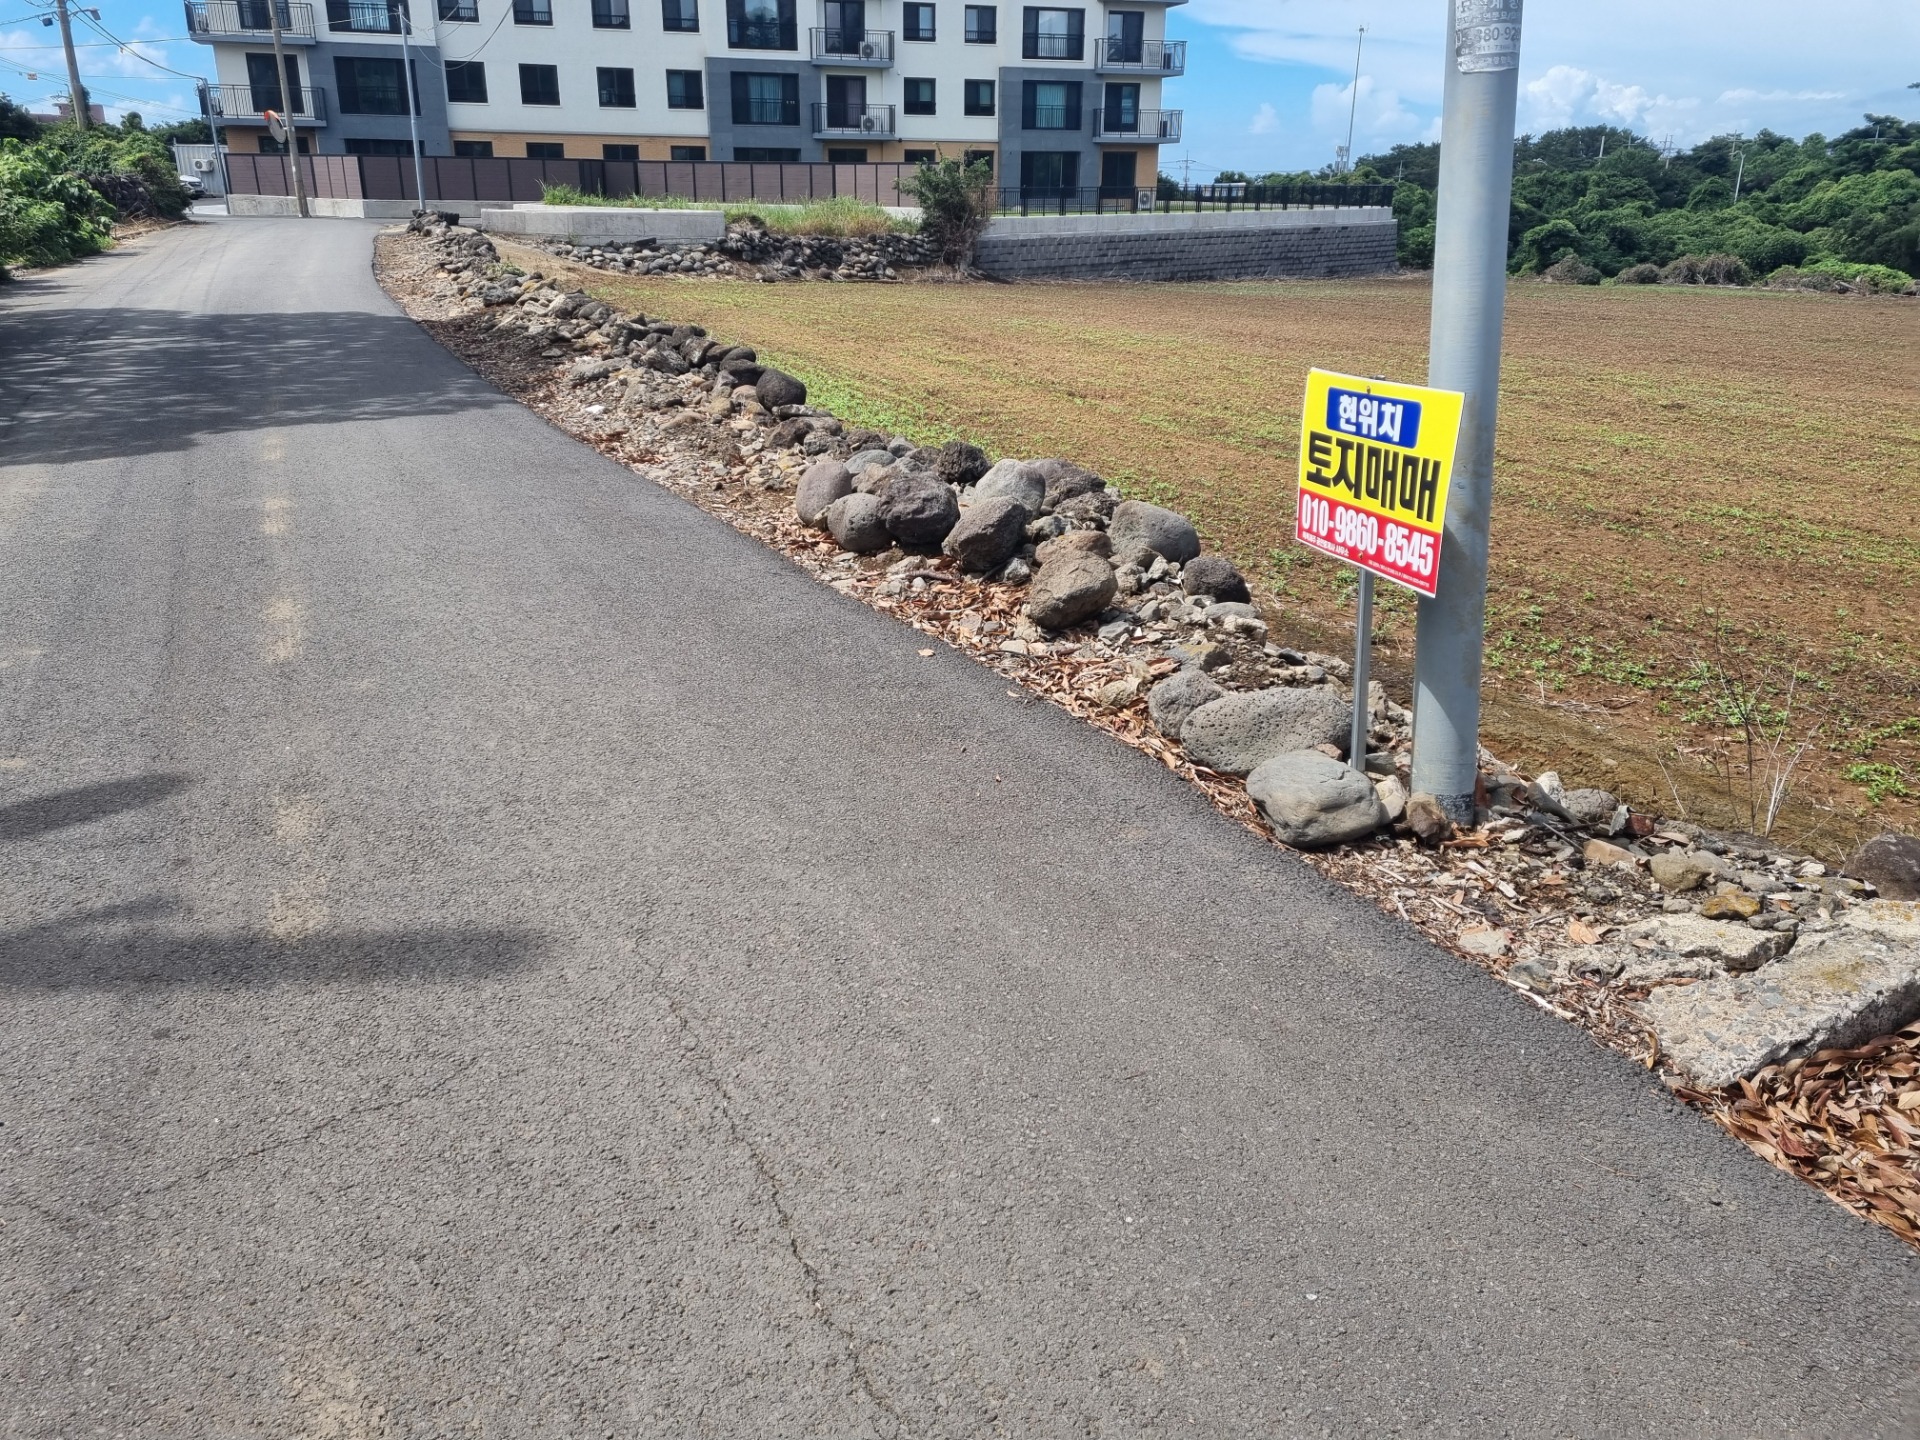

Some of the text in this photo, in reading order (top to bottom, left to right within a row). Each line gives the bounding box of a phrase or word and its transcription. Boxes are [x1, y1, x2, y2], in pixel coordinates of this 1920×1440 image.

[1339, 394, 1404, 443] 현위치
[1306, 430, 1442, 523] 토지매매
[1301, 493, 1435, 576] 010-9860-8545
